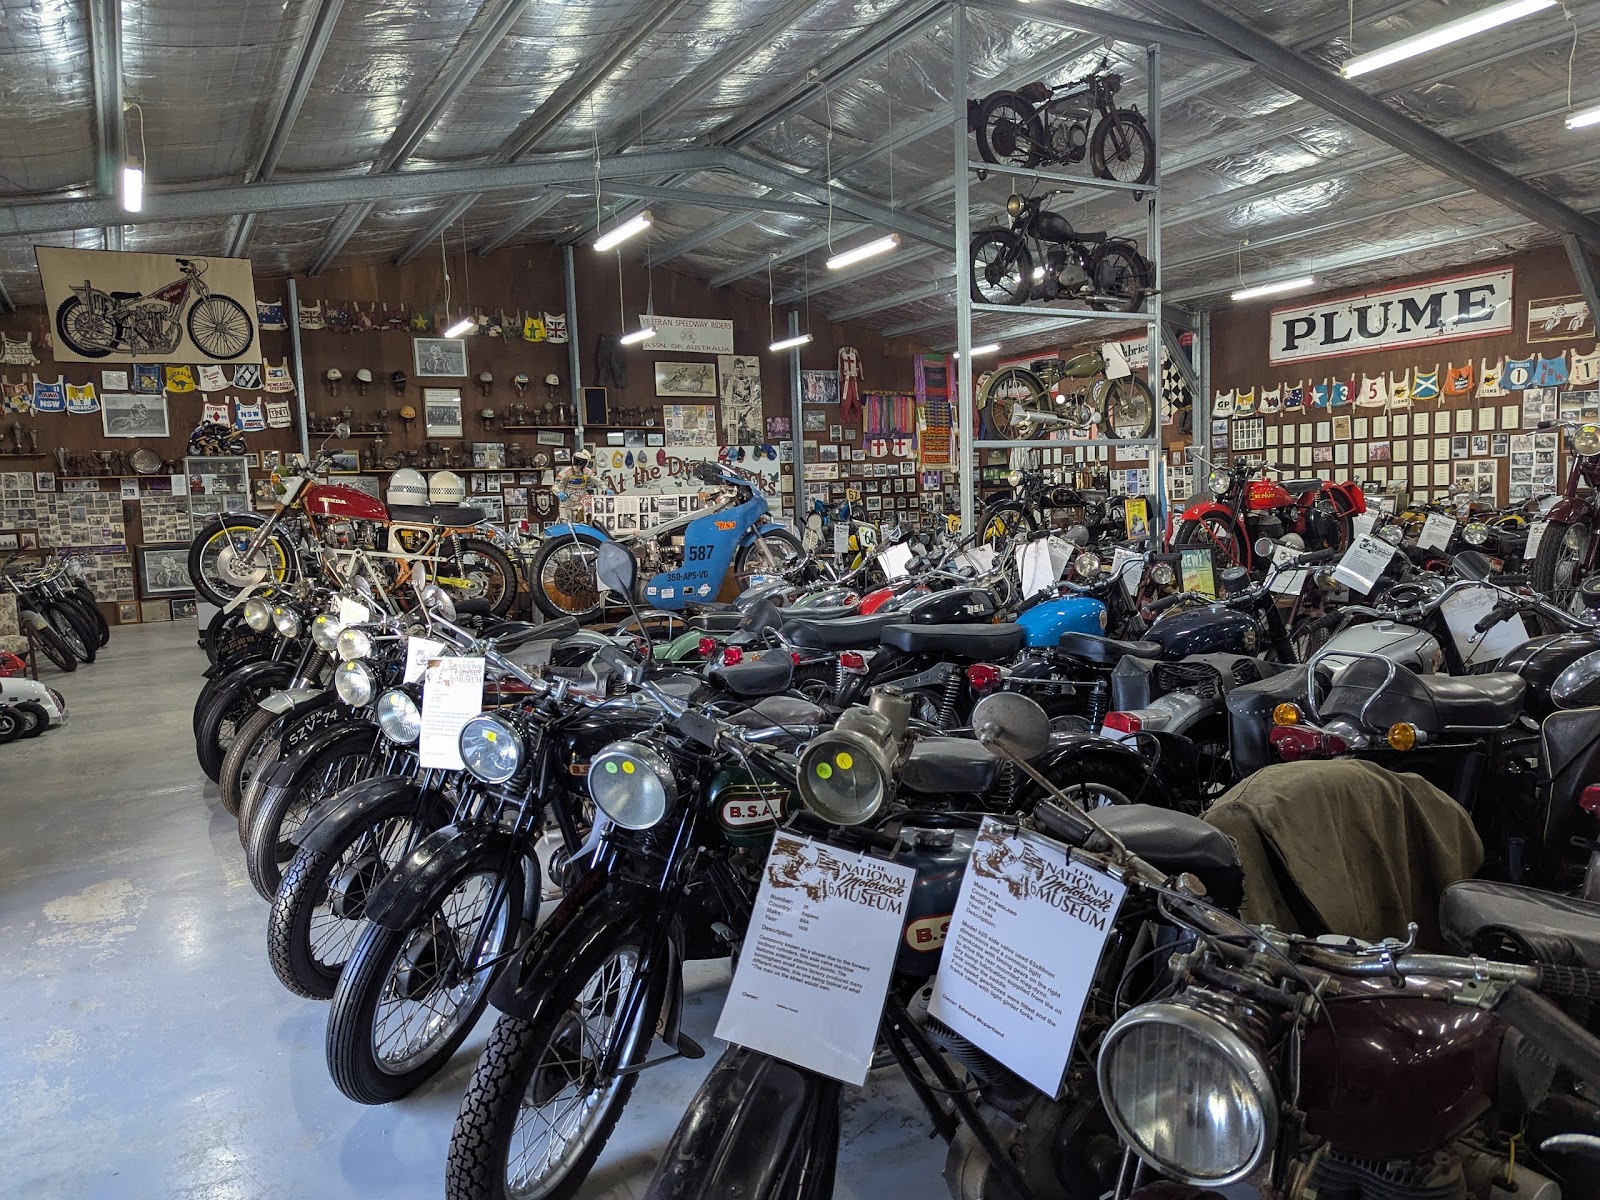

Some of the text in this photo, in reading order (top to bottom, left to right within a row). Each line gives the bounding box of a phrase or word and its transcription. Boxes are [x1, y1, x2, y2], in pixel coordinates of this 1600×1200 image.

[641, 318, 672, 326] VETERAN
[675, 320, 708, 328] SPEEDWAY
[1282, 284, 1496, 352] PLUME
[686, 344, 730, 352] AUSTRALIA
[167, 371, 192, 382] AUSTRALIA
[1517, 369, 1521, 382] 1
[1584, 362, 1589, 377] 1
[1340, 386, 1348, 400] 3
[1369, 382, 1378, 399] 5
[40, 400, 60, 408] NSW
[269, 408, 288, 418] TNT
[604, 472, 627, 495] At
[633, 465, 661, 488] the
[848, 490, 858, 500] 67
[1248, 492, 1275, 500] Excelsior
[689, 544, 715, 561] 587
[666, 570, 708, 582] 350-APS-VG
[304, 710, 323, 725] NSW
[289, 709, 338, 745] SZV-74
[840, 754, 848, 767] K
[819, 766, 828, 774] 25
[730, 805, 778, 818] B.S.A.
[840, 861, 909, 888] NATIONAL
[867, 862, 886, 872] THE
[1072, 866, 1095, 882] THE
[836, 872, 906, 899] Motorcycle
[973, 880, 989, 893] Make:
[1045, 861, 1116, 904] NATIONAL
[769, 893, 794, 905] Number:
[833, 883, 903, 915] MUSEUM
[970, 886, 994, 904] Country:
[1038, 874, 1111, 913] Motorcycle
[766, 907, 783, 916] Make:
[767, 900, 819, 920] Country: England
[1034, 883, 1107, 932] MUSEUM
[965, 906, 997, 930] Description:
[761, 924, 793, 939] Description
[961, 919, 1029, 963] Model side valve used
[755, 945, 774, 955] features
[775, 951, 793, 960] sidecar
[792, 957, 819, 969] attachment
[758, 934, 783, 946] Commonly
[784, 942, 800, 950] known
[851, 962, 870, 971] forward
[959, 926, 989, 947] dimensions
[989, 944, 1000, 954] and
[1004, 953, 1027, 970] common
[1027, 967, 1041, 980] light
[753, 951, 782, 964] birmingham
[808, 968, 825, 978] factory
[825, 973, 849, 985] produced
[848, 981, 863, 989] many
[833, 963, 854, 973] machine
[952, 951, 964, 962] tank
[964, 959, 979, 972] under
[979, 968, 988, 977] the
[957, 932, 1061, 1000] crankcase with timing gears on the right
[961, 943, 975, 954] drive
[975, 951, 984, 960] the
[984, 957, 995, 967] rear
[995, 963, 1019, 981] mounted
[752, 957, 772, 967] different
[811, 975, 825, 984] being
[825, 979, 842, 989] typical
[848, 986, 861, 994] what
[789, 975, 803, 983] street
[803, 979, 818, 987] would
[953, 945, 1062, 1015] Dry sump lubrication supplied from the oil
[949, 964, 1035, 1022] frame came with light girder forks.
[950, 958, 1057, 1028] Four speed gearboxes were fitted and the
[957, 1003, 976, 1019] Edward
